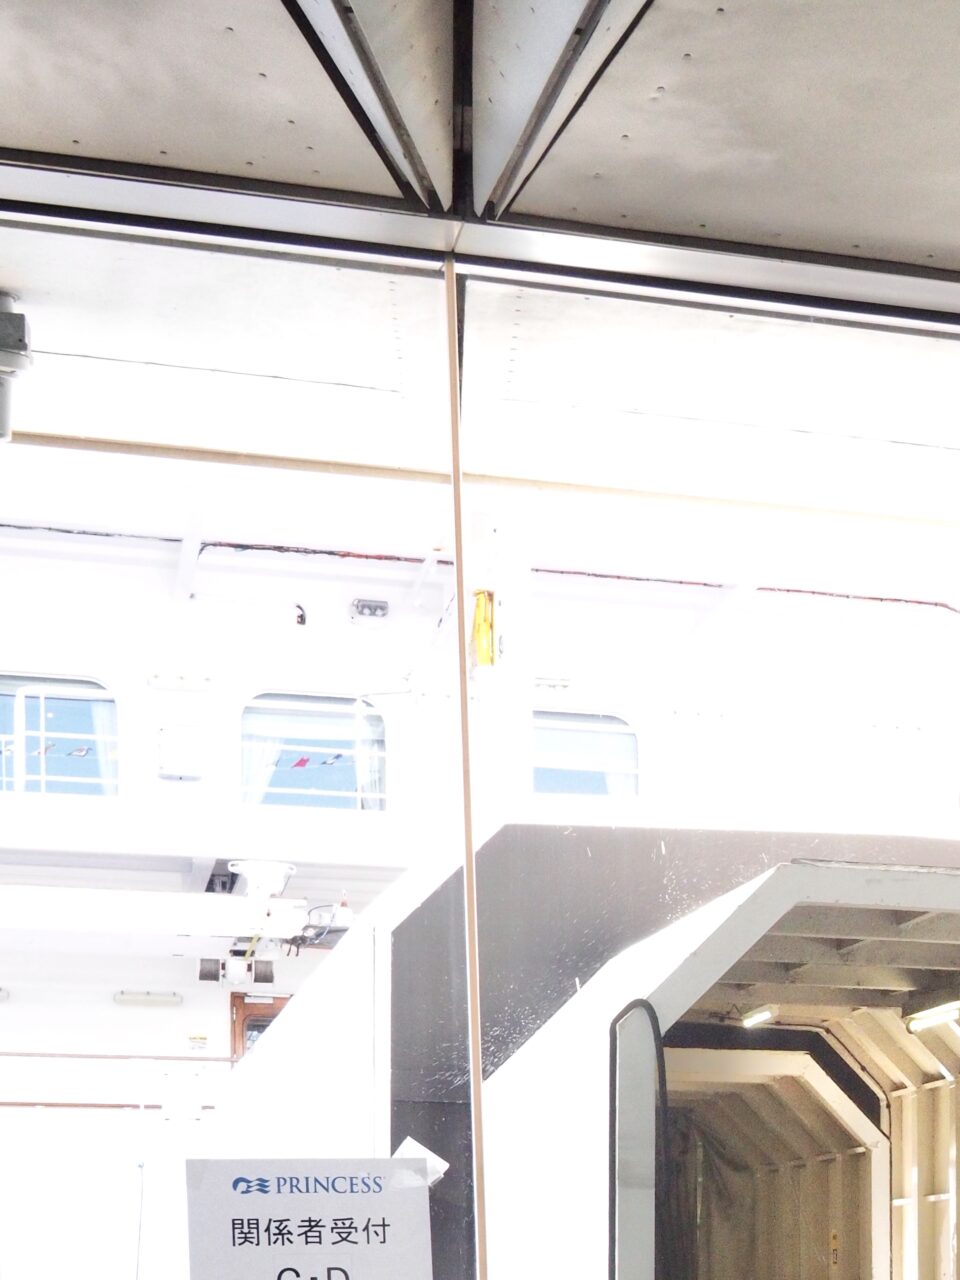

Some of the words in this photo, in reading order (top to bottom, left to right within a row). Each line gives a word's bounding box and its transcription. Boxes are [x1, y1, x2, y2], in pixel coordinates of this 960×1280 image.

[276, 1176, 384, 1194] PRINCESS
[231, 1216, 391, 1247] 関係者受付
